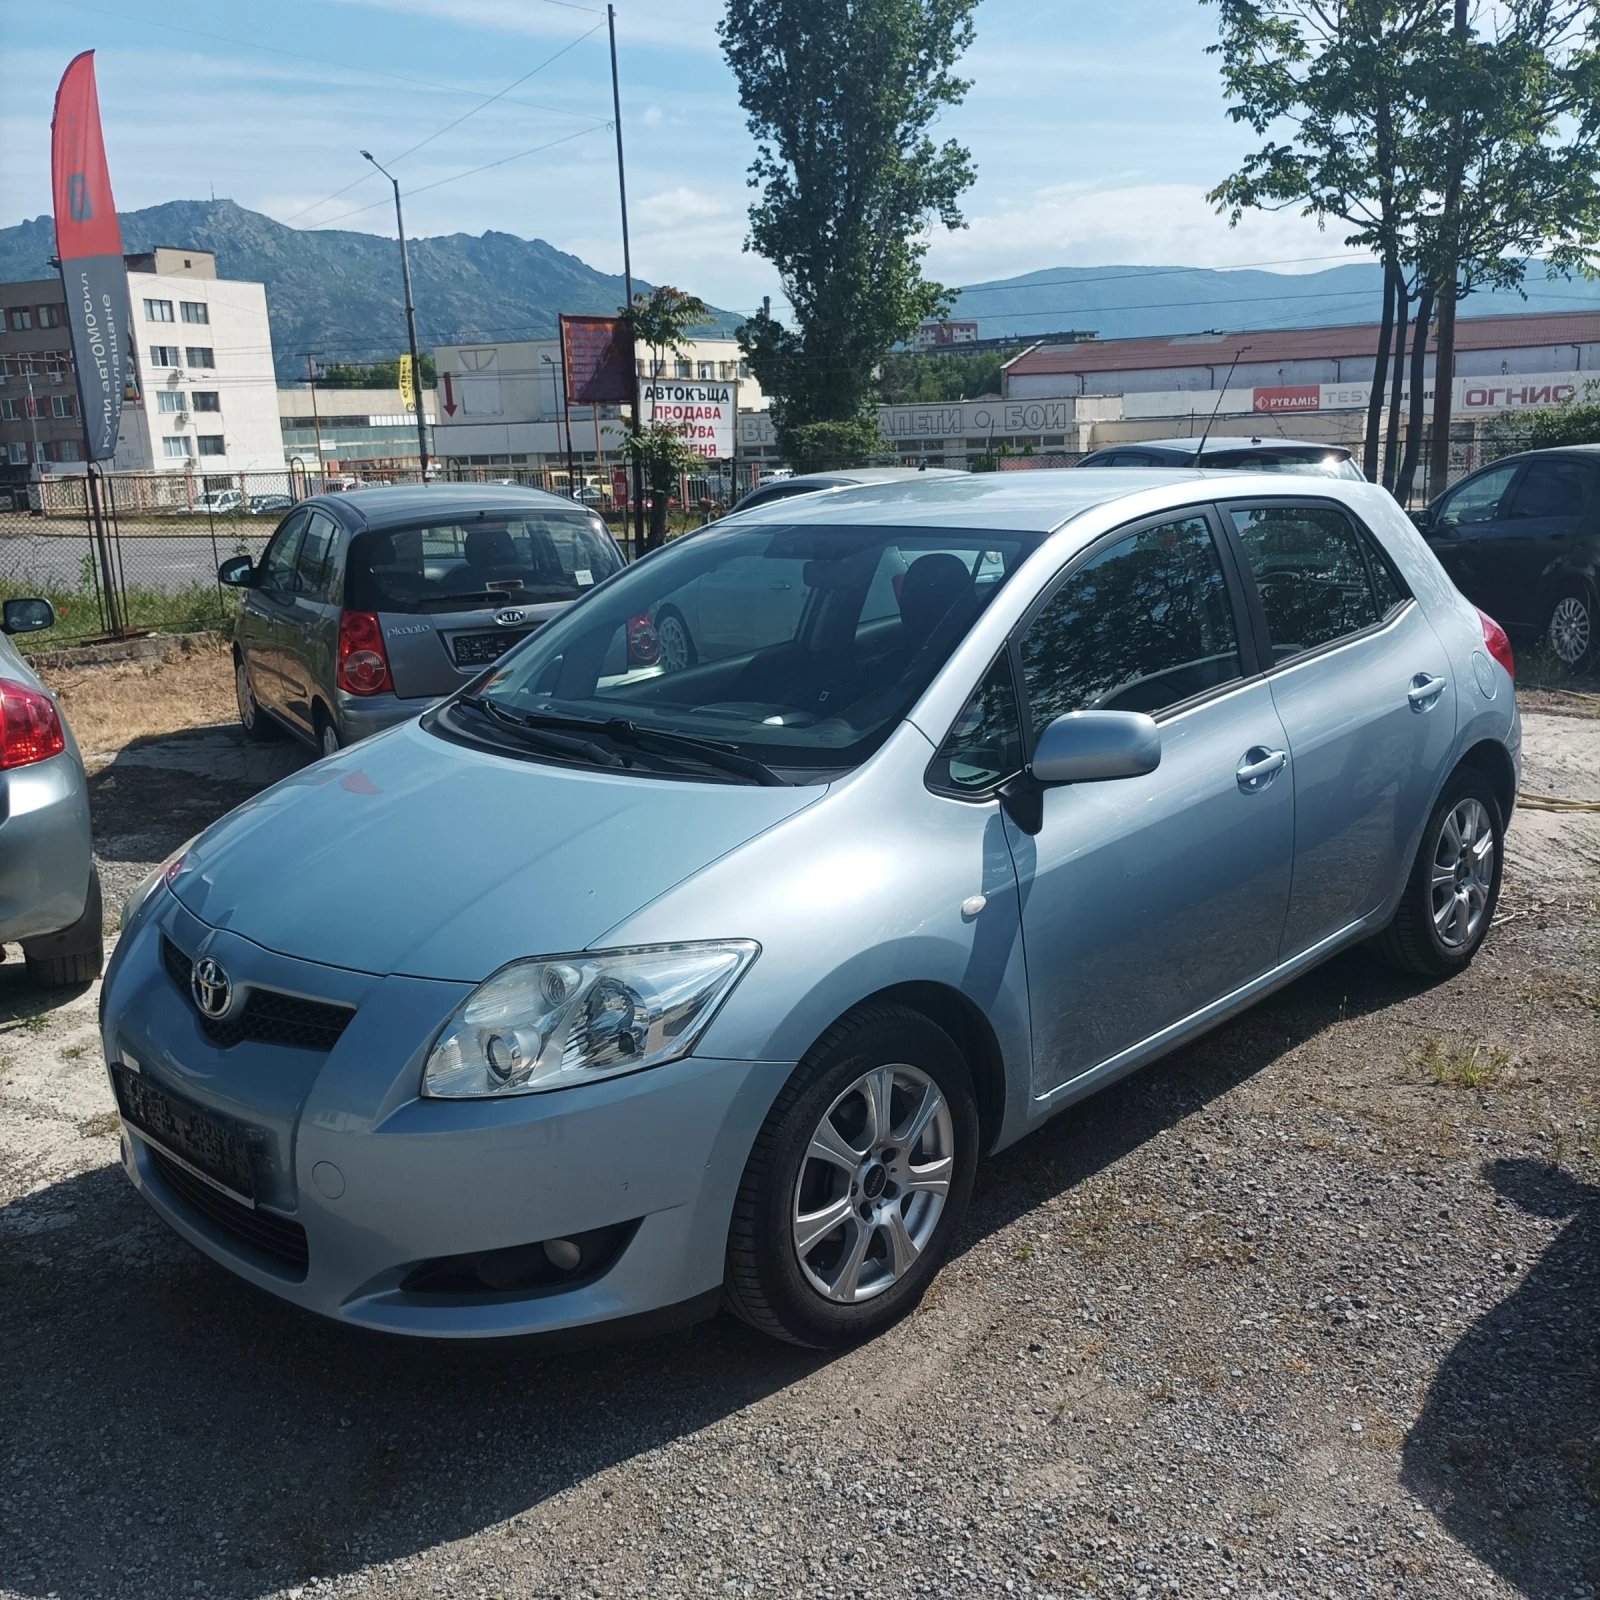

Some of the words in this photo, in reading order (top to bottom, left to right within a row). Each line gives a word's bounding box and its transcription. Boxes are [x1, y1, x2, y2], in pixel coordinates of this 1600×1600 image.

[81, 273, 110, 392] автомобил
[645, 386, 729, 404] АВТОКЪЩА
[1270, 396, 1318, 407] PYRAMIS
[654, 406, 721, 422] ПРОДАВА
[879, 409, 961, 437] АПЕТИ
[1004, 403, 1066, 431] БОИ
[102, 399, 112, 448] Купи
[501, 612, 521, 622] KIA
[387, 624, 430, 638] picanto
